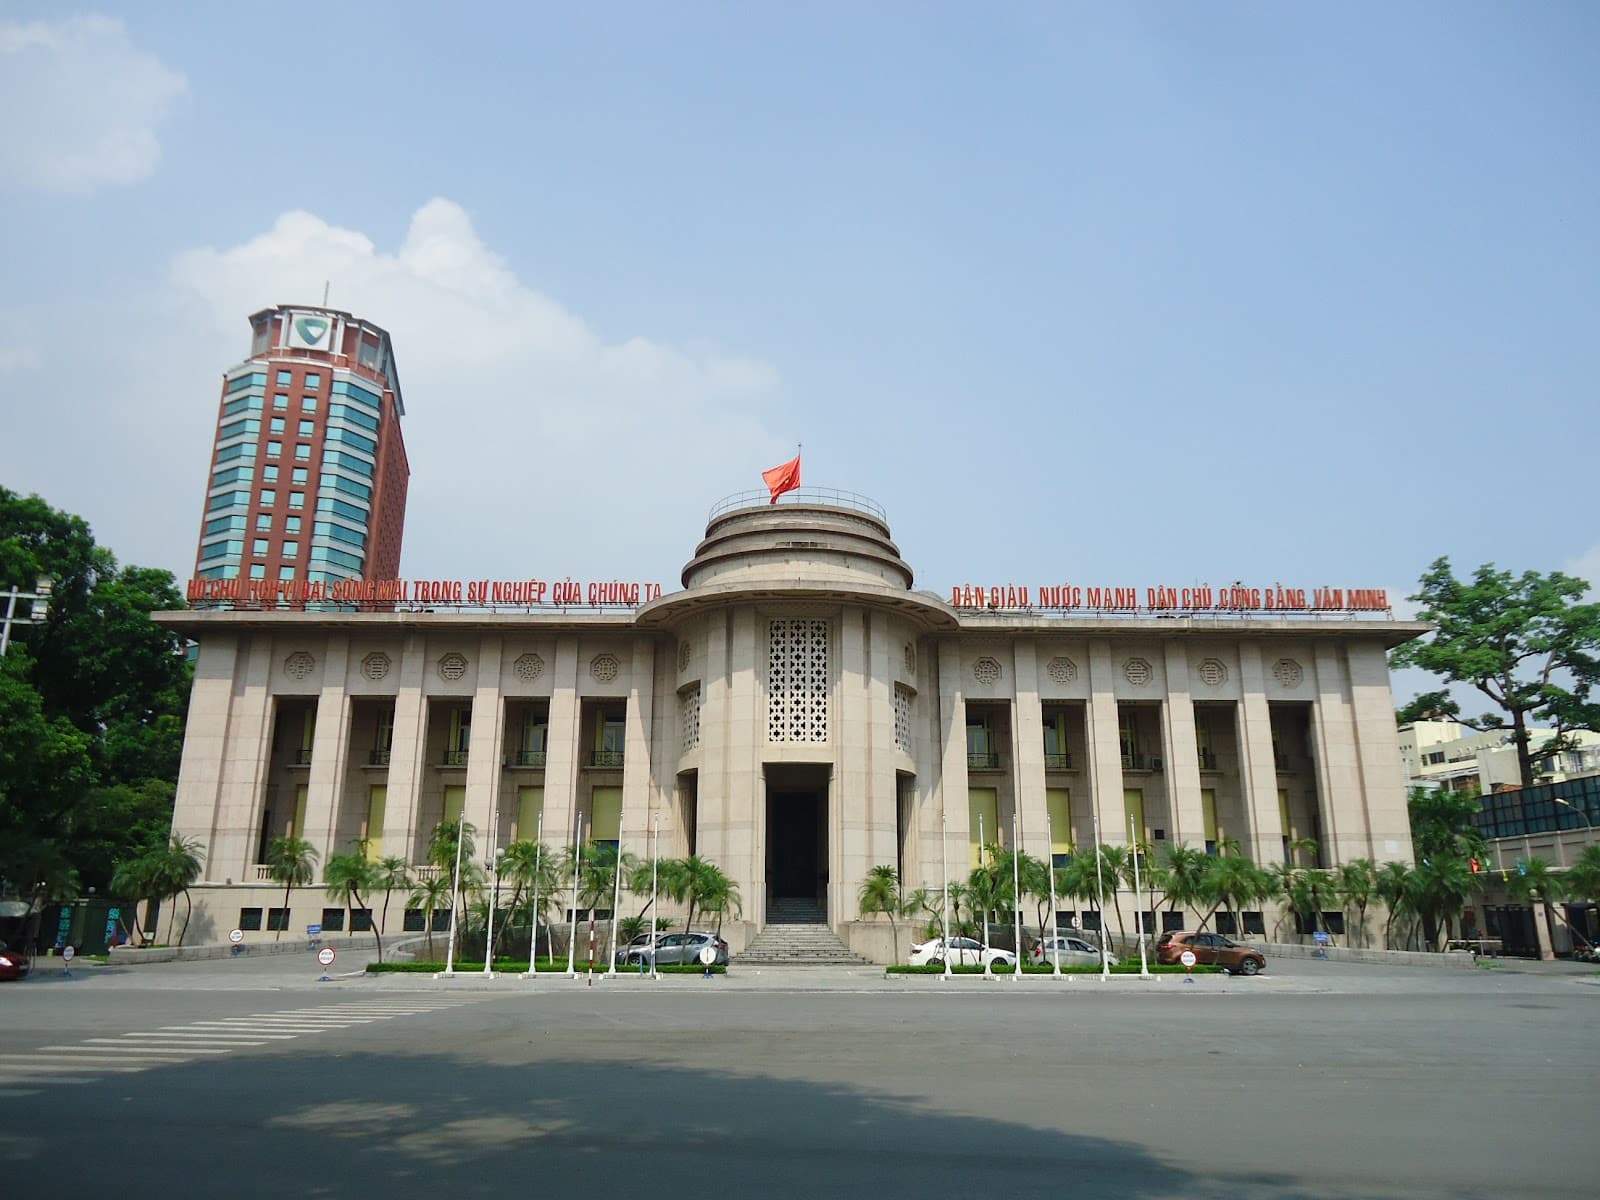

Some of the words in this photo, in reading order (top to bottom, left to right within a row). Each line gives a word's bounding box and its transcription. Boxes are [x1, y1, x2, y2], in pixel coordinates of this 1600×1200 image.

[413, 581, 462, 602] TRONG
[467, 579, 489, 606] SỰ
[491, 579, 547, 605] NGHIỆP
[552, 577, 582, 602] CỦA
[588, 580, 640, 603] CHÚNG
[644, 584, 663, 602] TA
[952, 583, 984, 607] DÂN
[991, 583, 1033, 608] GIÀU,
[1039, 582, 1081, 607] NƯỚC
[1147, 585, 1178, 608] DÂN
[1219, 584, 1261, 608] CÔNG
[1314, 585, 1344, 609] VĂN
